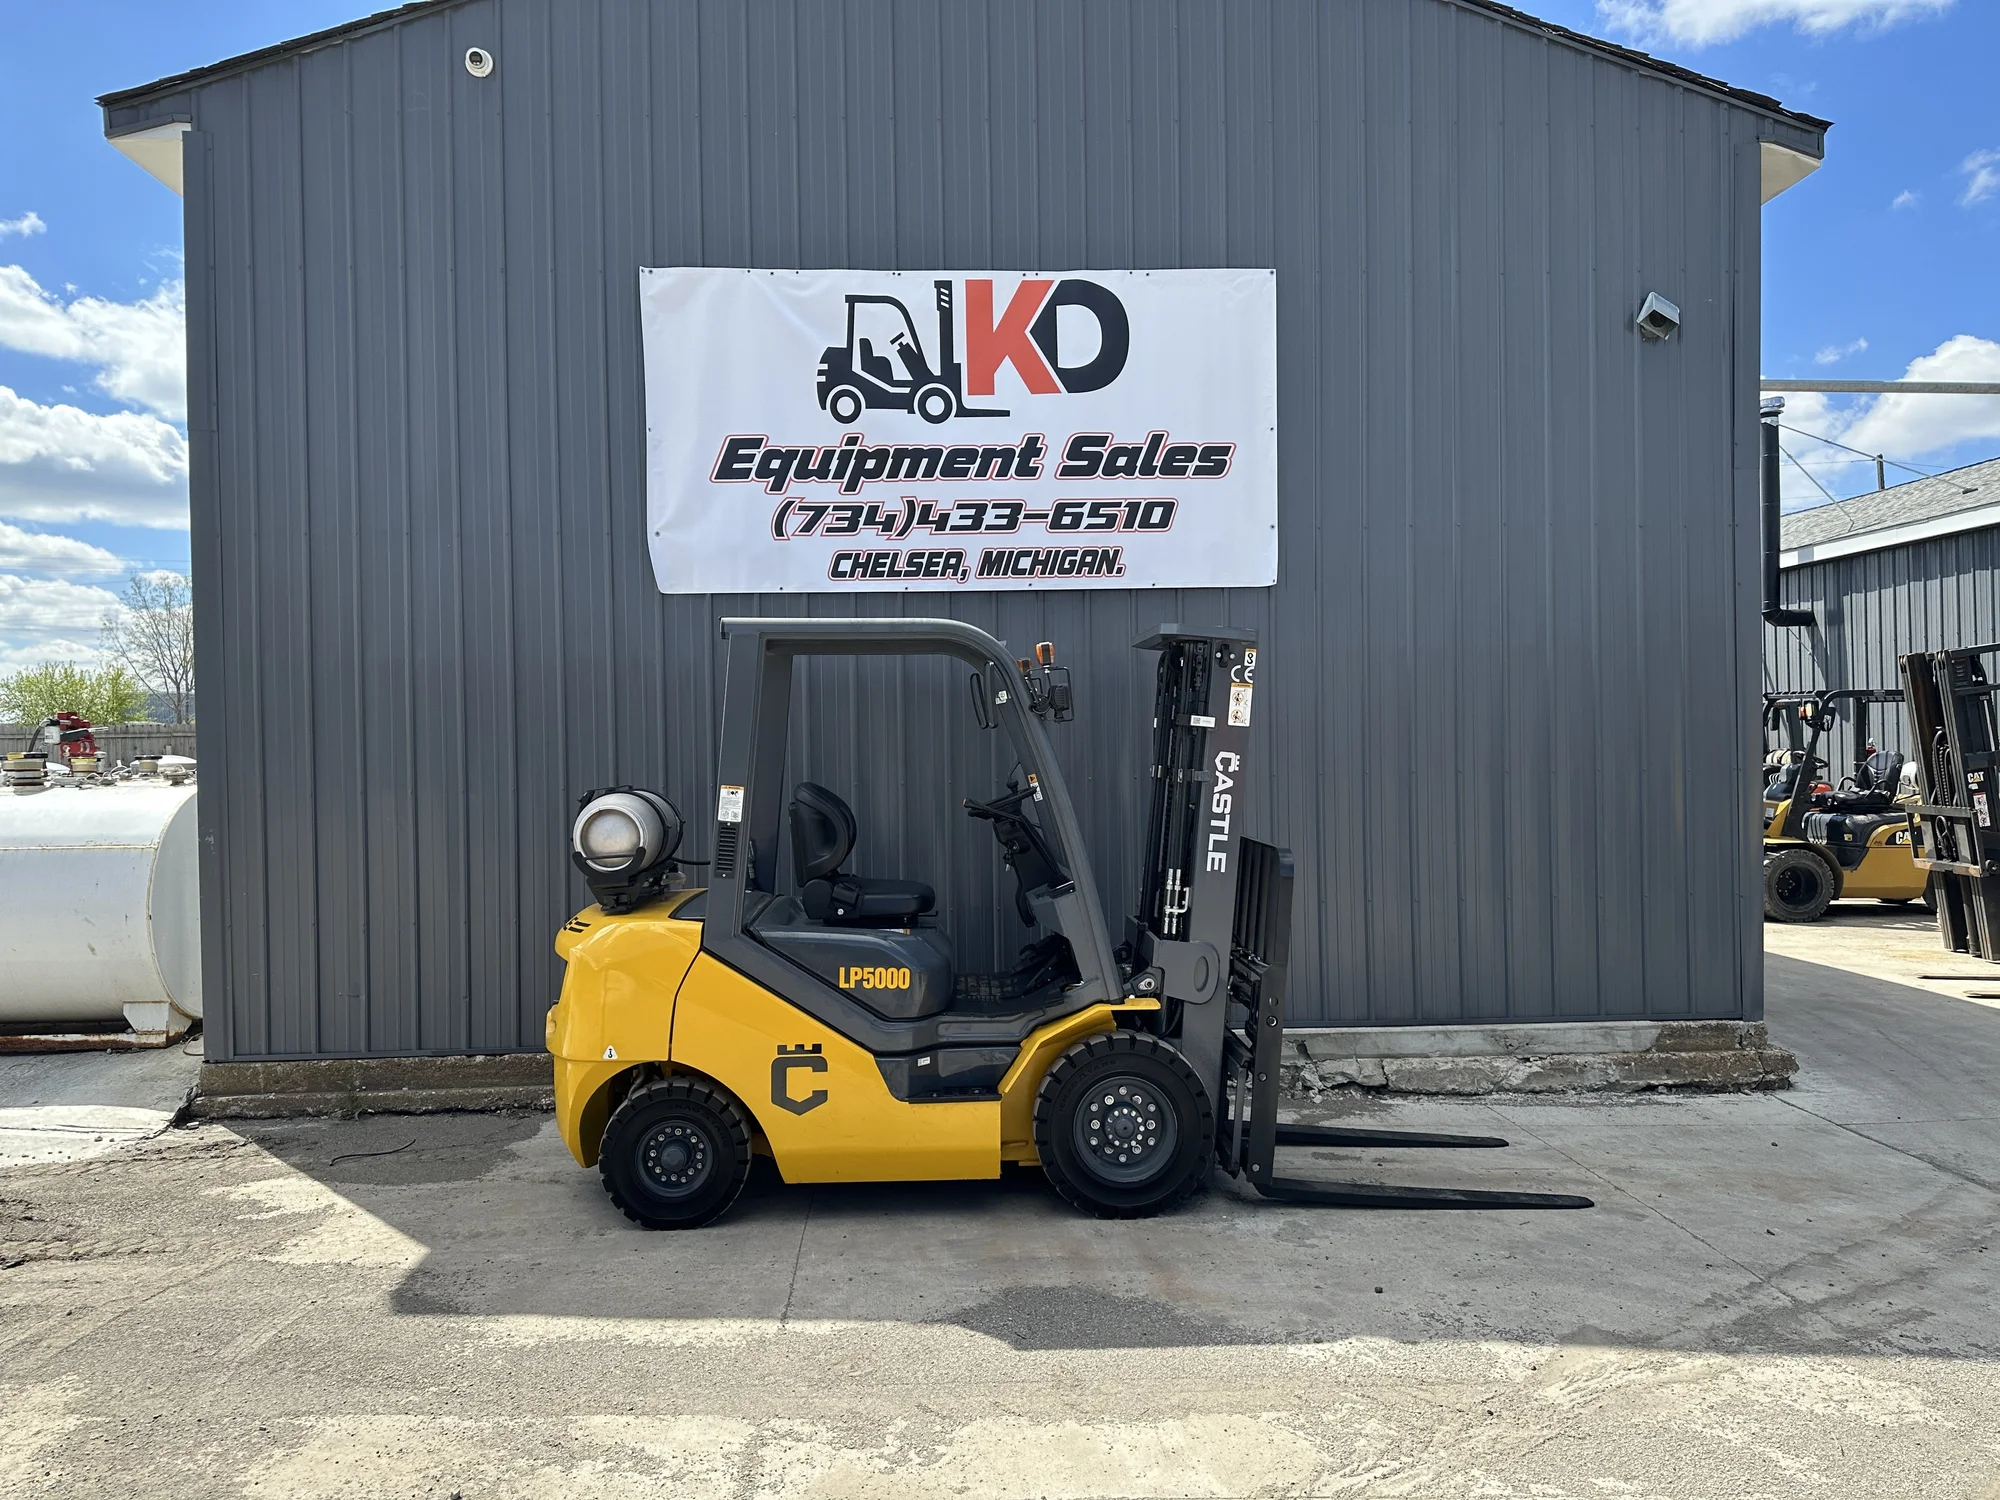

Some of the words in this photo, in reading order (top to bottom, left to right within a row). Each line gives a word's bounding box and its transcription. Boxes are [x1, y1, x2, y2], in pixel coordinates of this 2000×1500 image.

[964, 278, 1130, 396] KD
[711, 433, 1046, 494] Equipment
[1056, 431, 1236, 480] Sales
[771, 497, 1178, 541] (734)433-6510
[829, 549, 969, 582] CHELSEA,
[975, 547, 1126, 579] MICHIGAN.
[1967, 771, 1984, 783] CAT
[1206, 751, 1238, 873] CASTLE
[838, 966, 911, 990] LP5000
